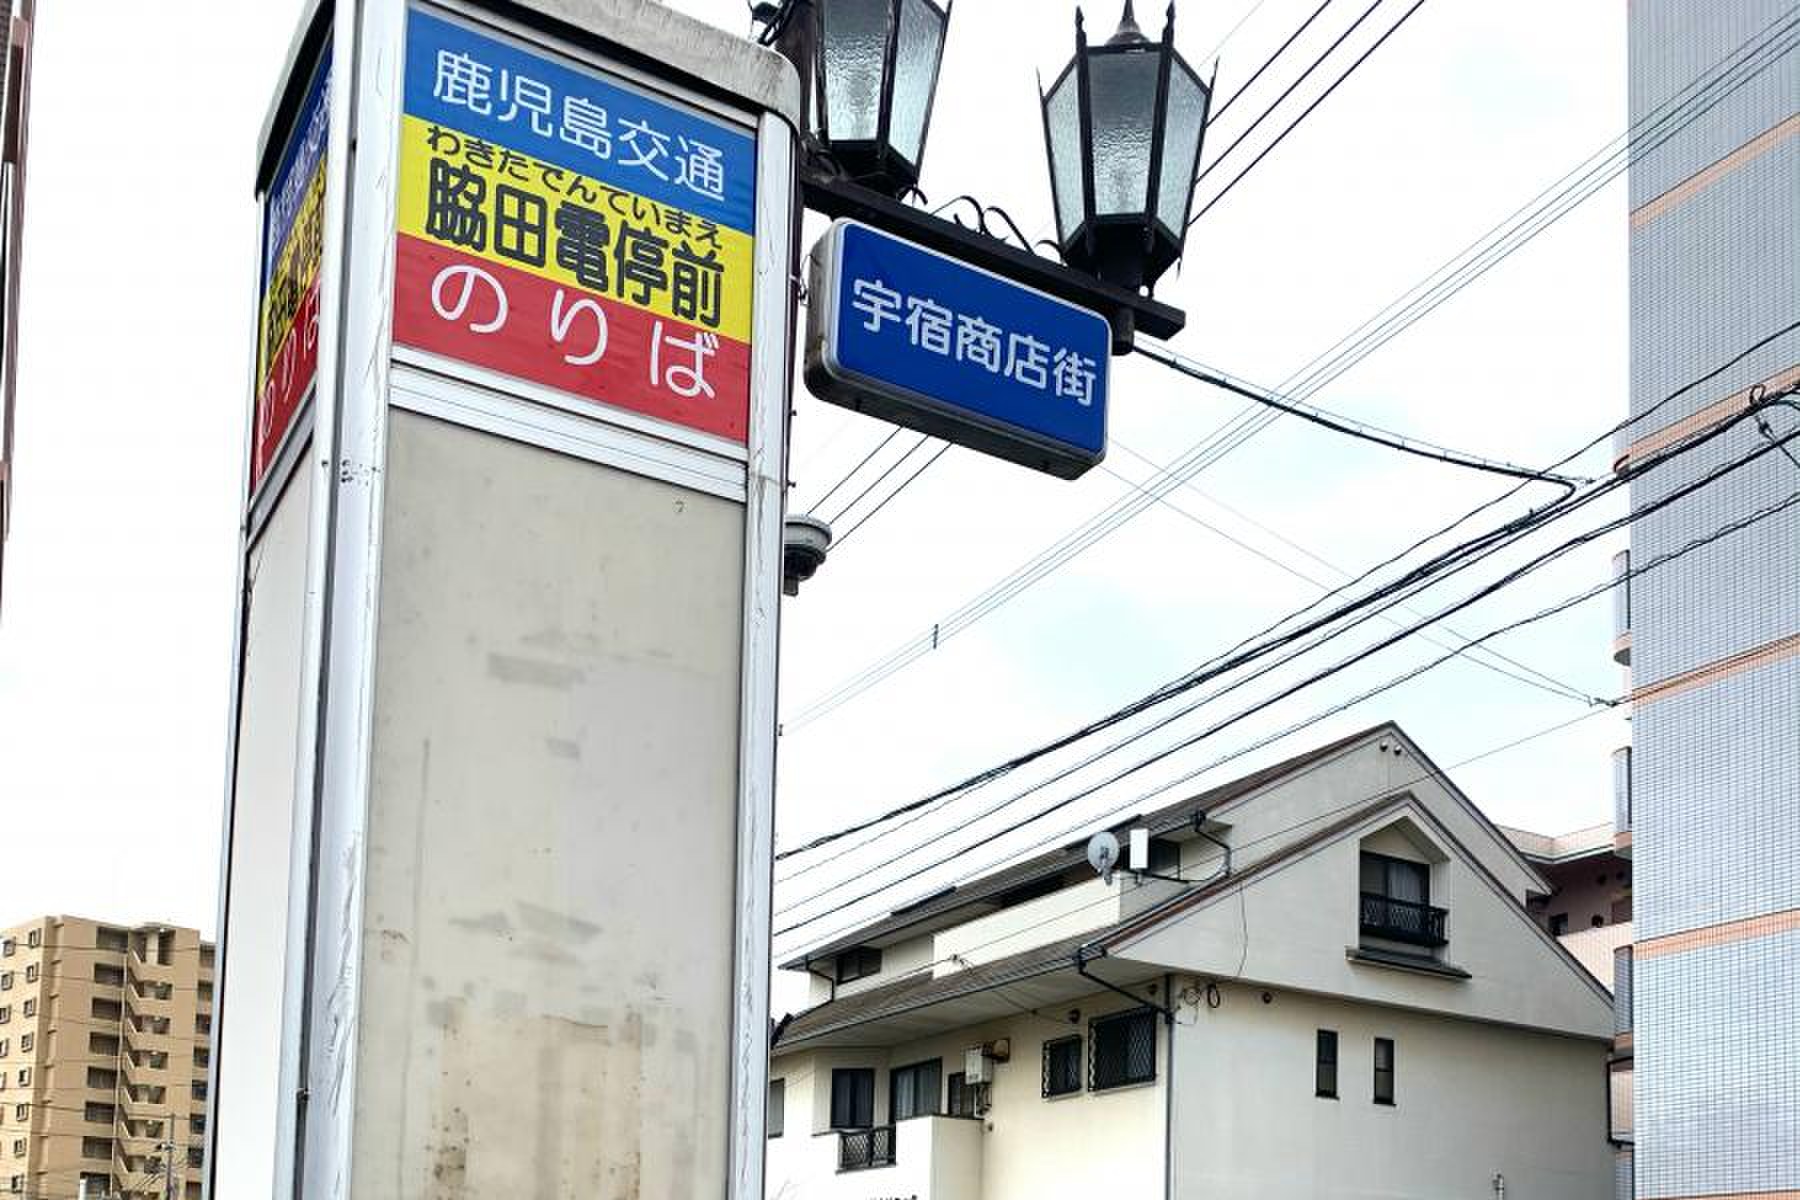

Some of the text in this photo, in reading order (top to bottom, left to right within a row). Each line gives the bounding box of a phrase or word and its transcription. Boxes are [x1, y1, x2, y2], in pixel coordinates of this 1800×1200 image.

[426, 124, 724, 251] わきたでんていまえ
[433, 49, 725, 202] 鹿児島交通
[425, 157, 725, 329] 脇田電停前
[430, 263, 720, 400] のりば
[851, 278, 1097, 407] 宇宿商店街
